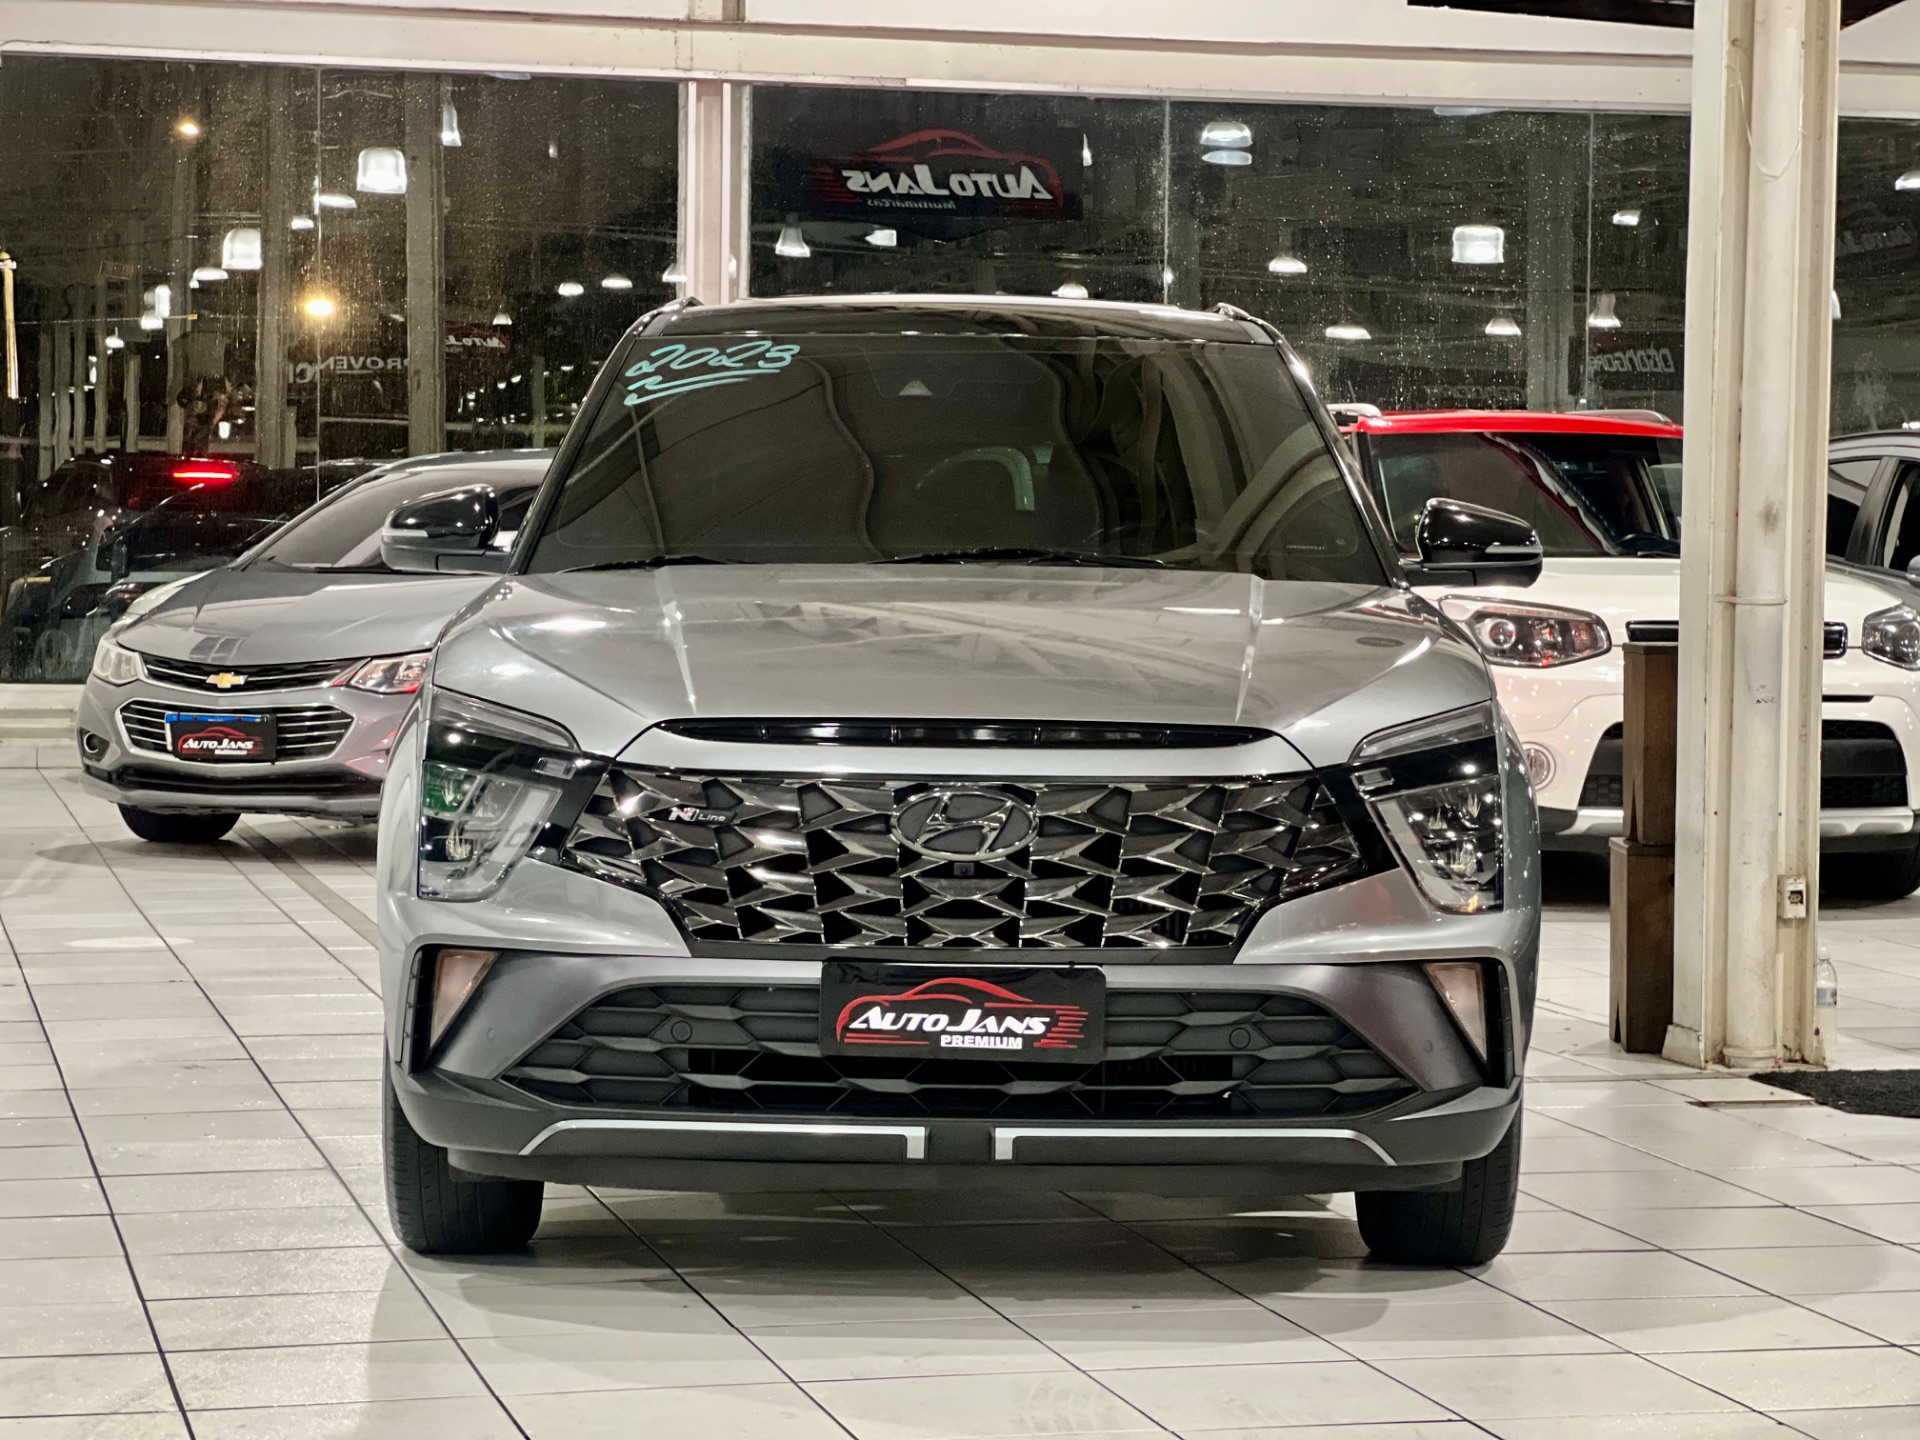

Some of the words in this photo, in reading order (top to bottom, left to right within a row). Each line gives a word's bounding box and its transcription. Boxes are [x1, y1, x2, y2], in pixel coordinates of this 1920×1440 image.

[624, 340, 800, 377] 2023
[182, 738, 218, 749] AUTO
[217, 738, 254, 750] JANS
[849, 1006, 949, 1031] AUTO
[946, 1008, 1050, 1035] JANS
[940, 1034, 1023, 1050] PREMIUM
